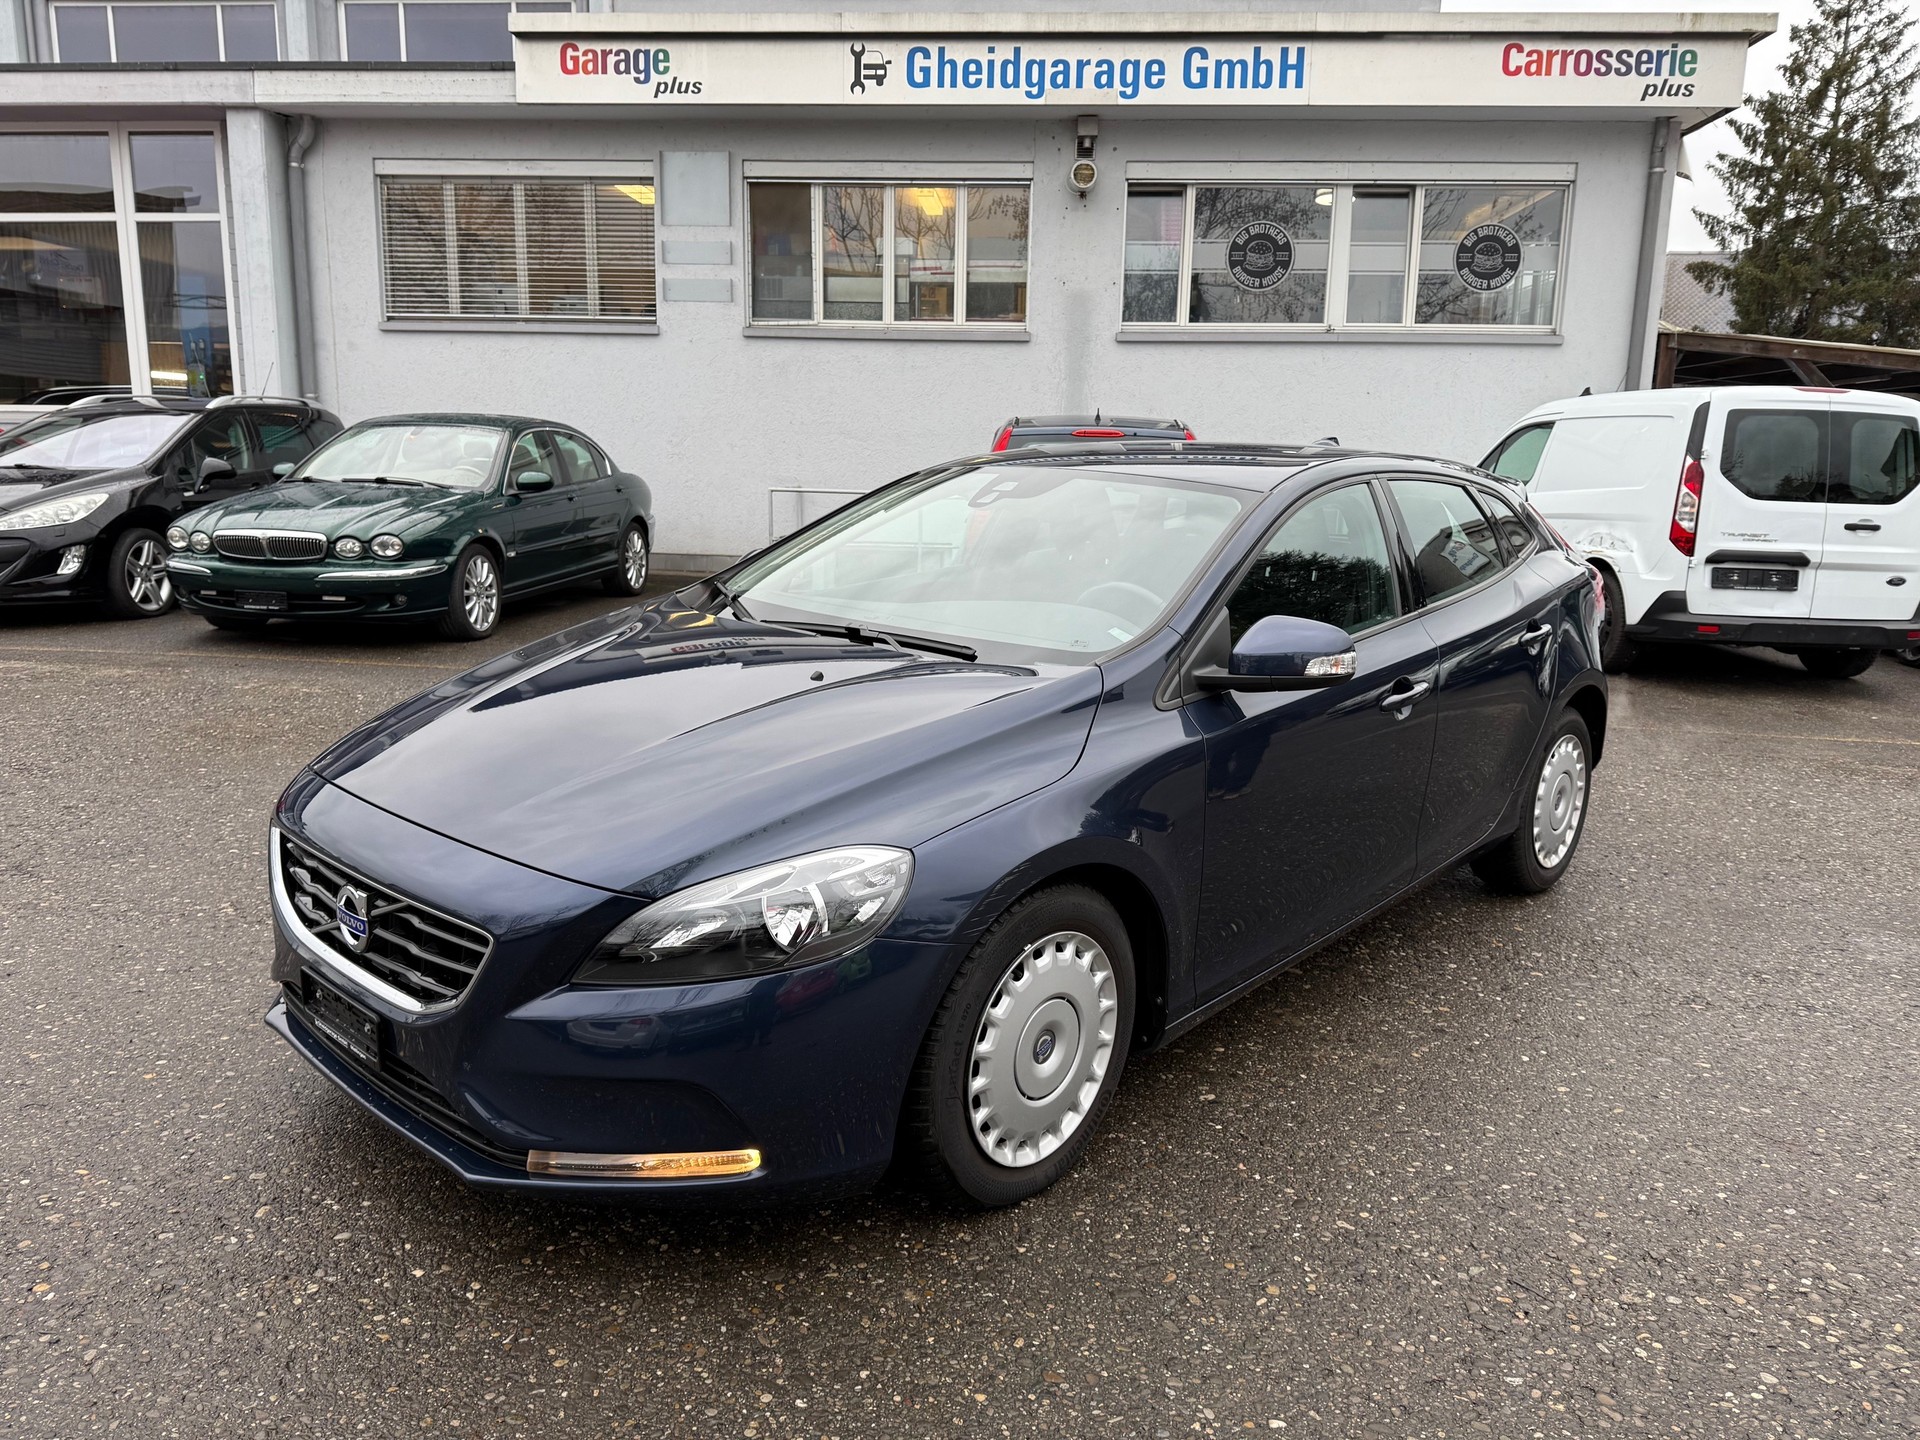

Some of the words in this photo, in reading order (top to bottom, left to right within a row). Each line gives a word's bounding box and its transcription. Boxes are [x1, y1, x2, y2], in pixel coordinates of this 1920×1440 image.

[559, 42, 670, 84] Garage
[1501, 42, 1698, 77] Carrosserie
[906, 46, 1166, 100] Gheidgarage
[1182, 46, 1306, 90] GmbH
[653, 77, 703, 98] plus
[1640, 78, 1695, 101] plus
[1234, 230, 1250, 246] BIG
[1248, 223, 1288, 246] BROTHERS
[1463, 232, 1478, 247] BIG
[1476, 225, 1517, 248] BROTHERS
[1231, 265, 1261, 288] BURGER
[1261, 265, 1287, 287] HOUSE
[1459, 267, 1489, 290] BURGER
[1489, 267, 1516, 289] HOUSE
[337, 910, 364, 932] VOLVO
